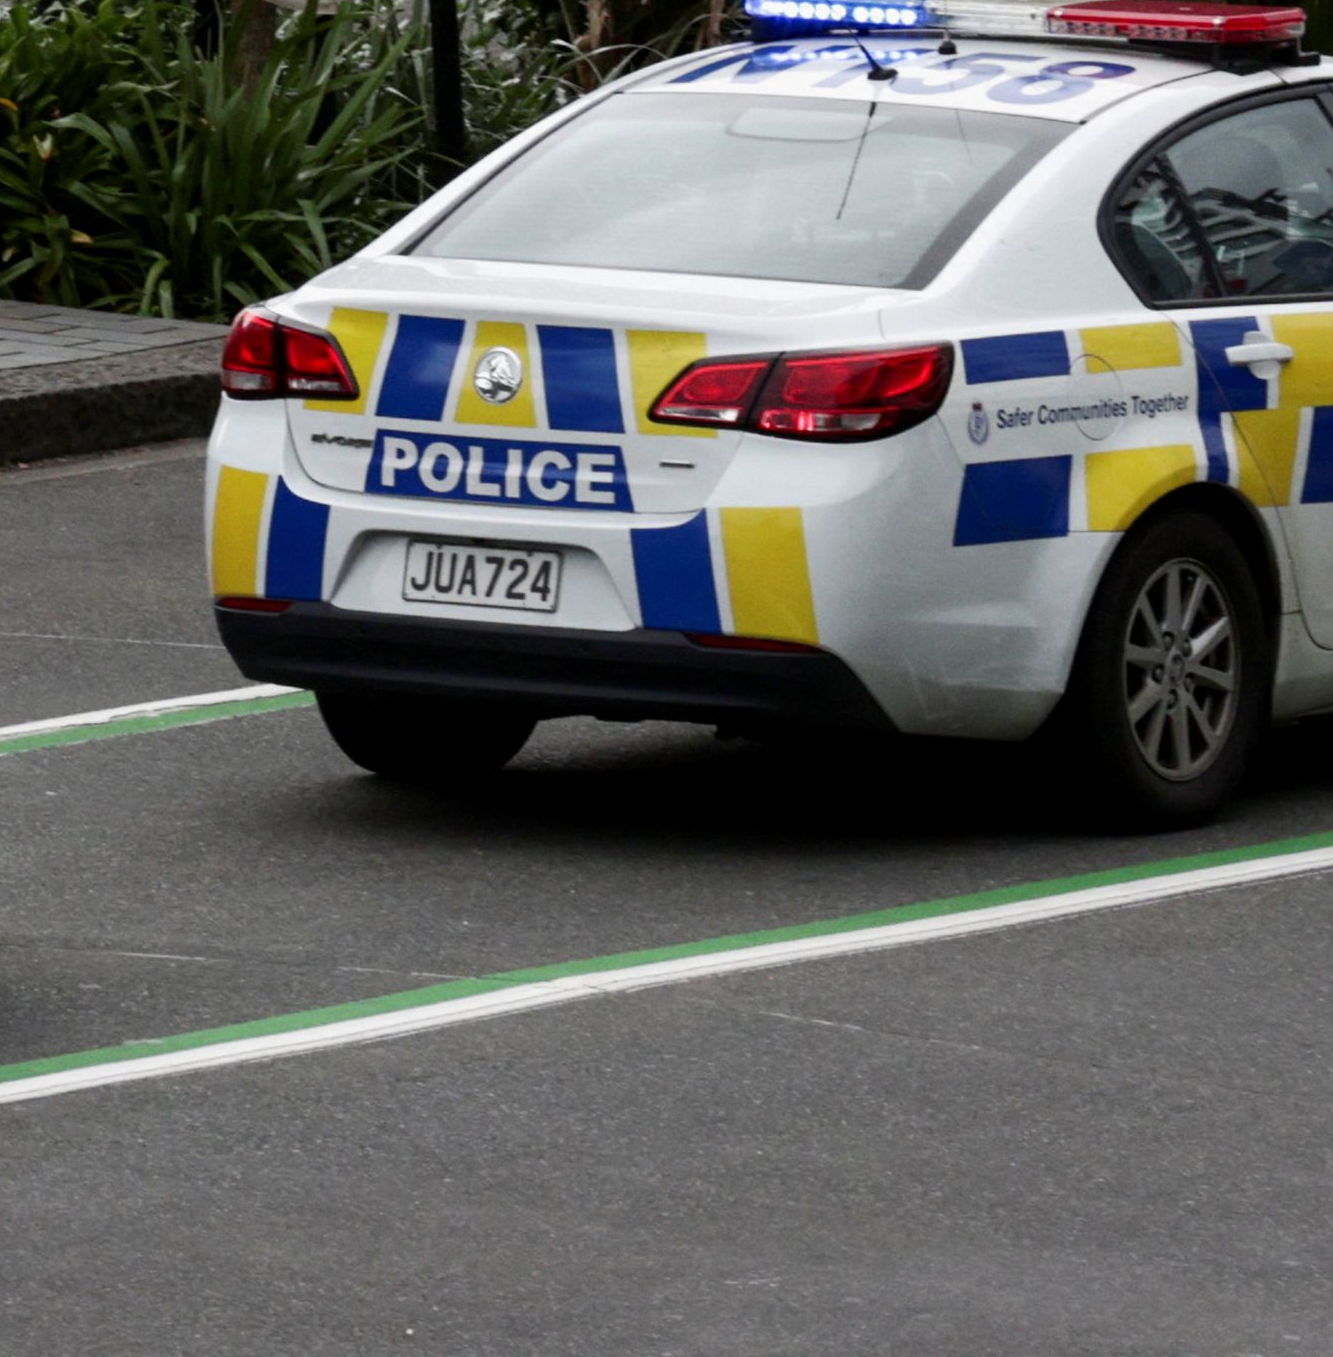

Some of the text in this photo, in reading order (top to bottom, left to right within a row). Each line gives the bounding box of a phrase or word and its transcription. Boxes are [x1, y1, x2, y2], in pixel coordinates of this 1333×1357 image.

[996, 391, 1190, 429] Safer Communities Together
[379, 436, 616, 505] POLICE
[410, 552, 551, 603] JUA724
